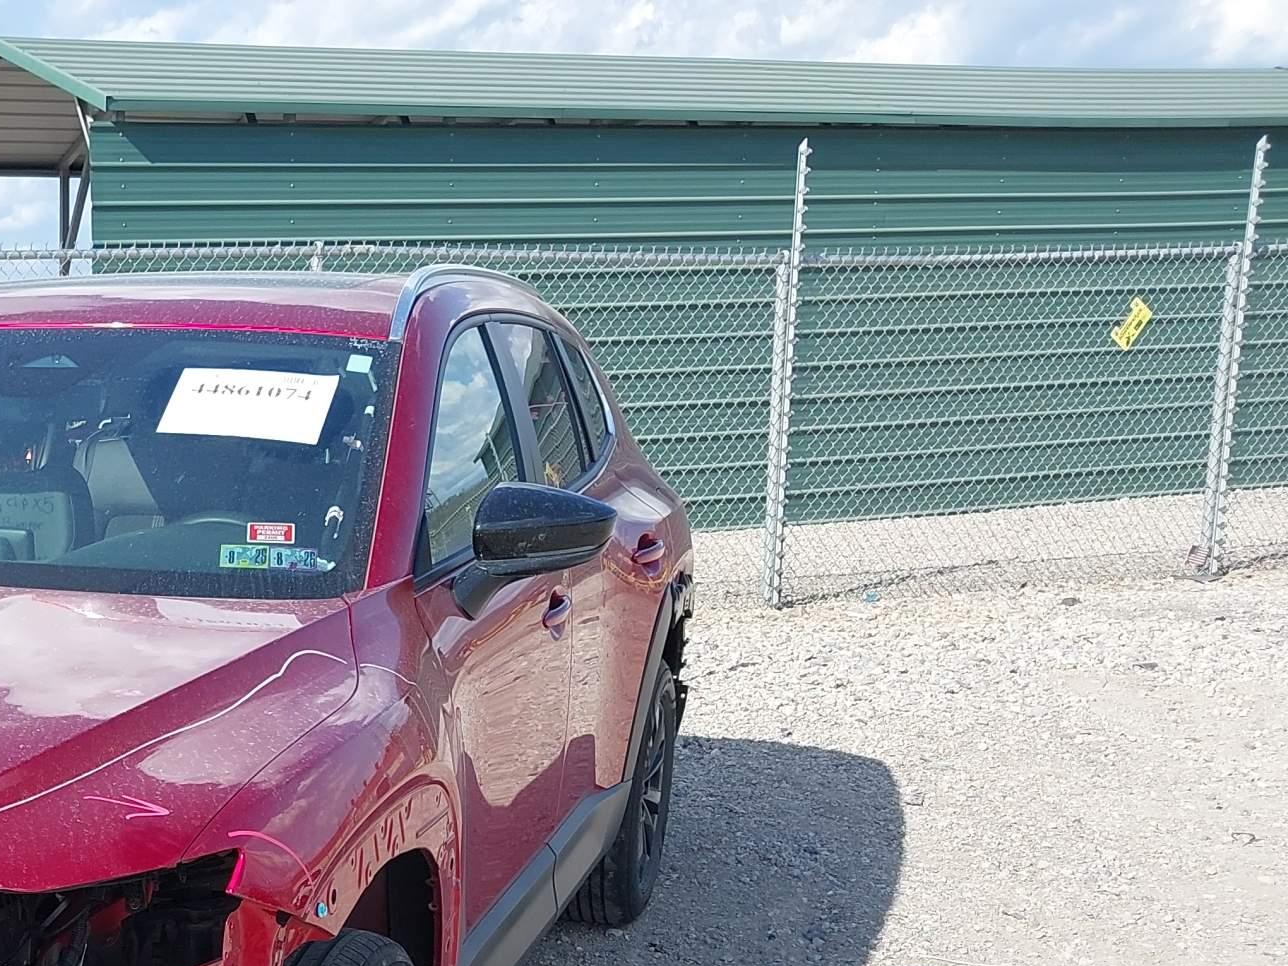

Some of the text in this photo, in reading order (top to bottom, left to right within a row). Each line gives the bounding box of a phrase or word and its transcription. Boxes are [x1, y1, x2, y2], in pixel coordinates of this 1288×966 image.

[191, 383, 312, 401] 44861074
[228, 550, 235, 564] 8
[276, 554, 284, 567] 8
[303, 551, 316, 568] 26
